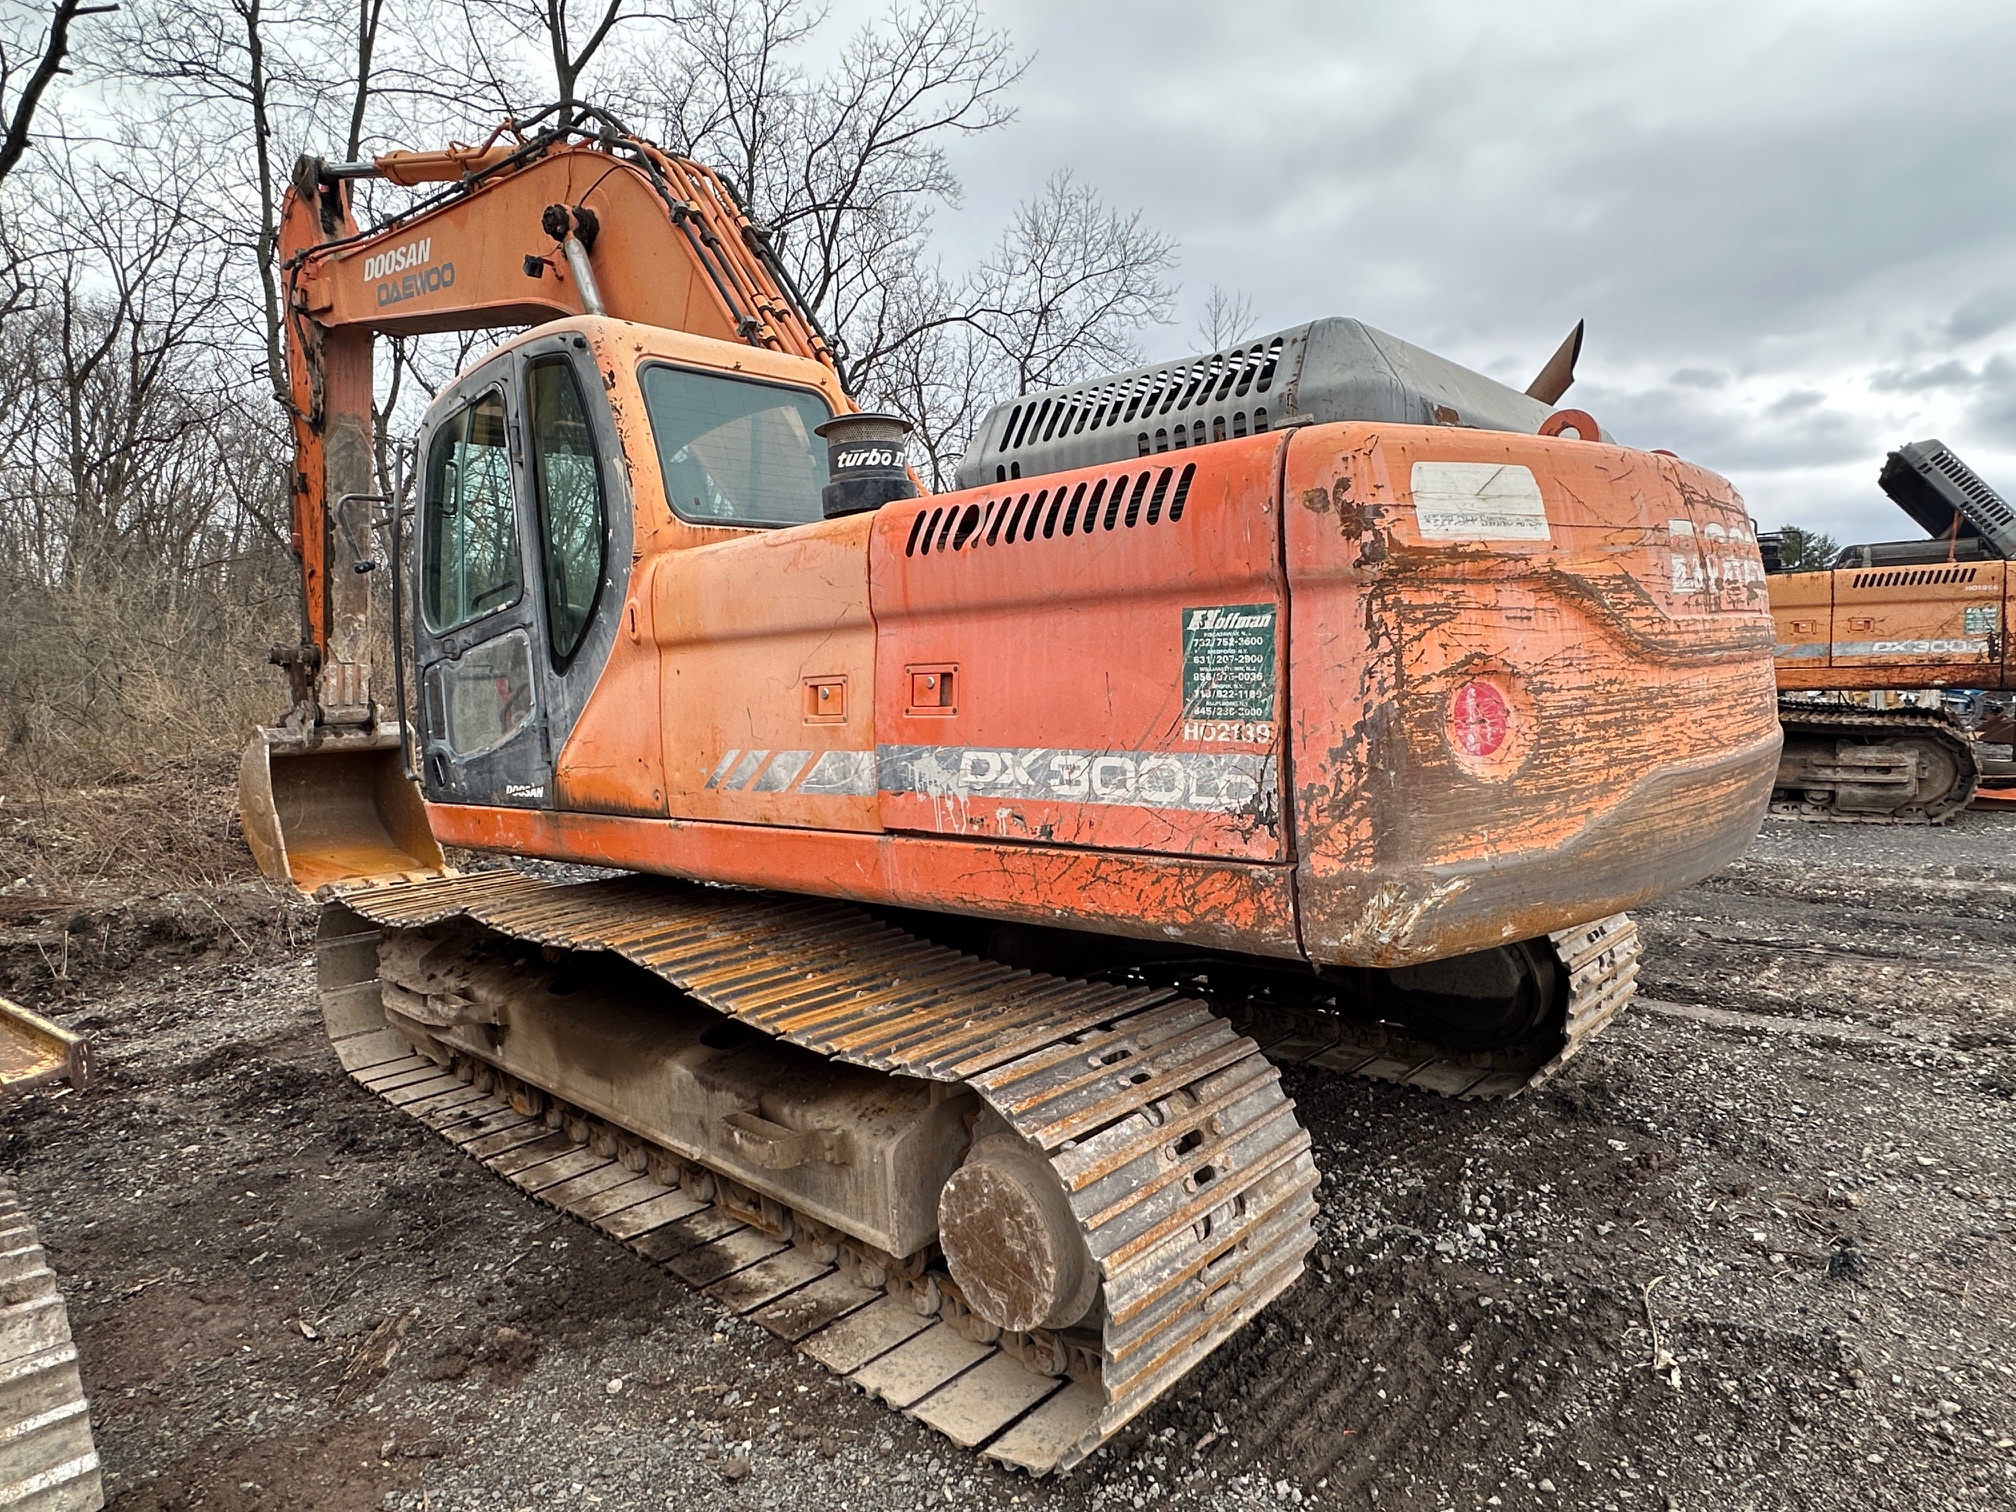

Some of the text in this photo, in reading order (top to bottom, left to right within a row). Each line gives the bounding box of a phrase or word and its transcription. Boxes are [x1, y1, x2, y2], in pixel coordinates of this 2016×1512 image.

[364, 237, 431, 282] DOOSAN
[377, 262, 455, 307] DAEWOO
[837, 448, 893, 468] turbo
[1193, 654, 1264, 664] 631/207-2900
[506, 782, 544, 798] DOOSAN
